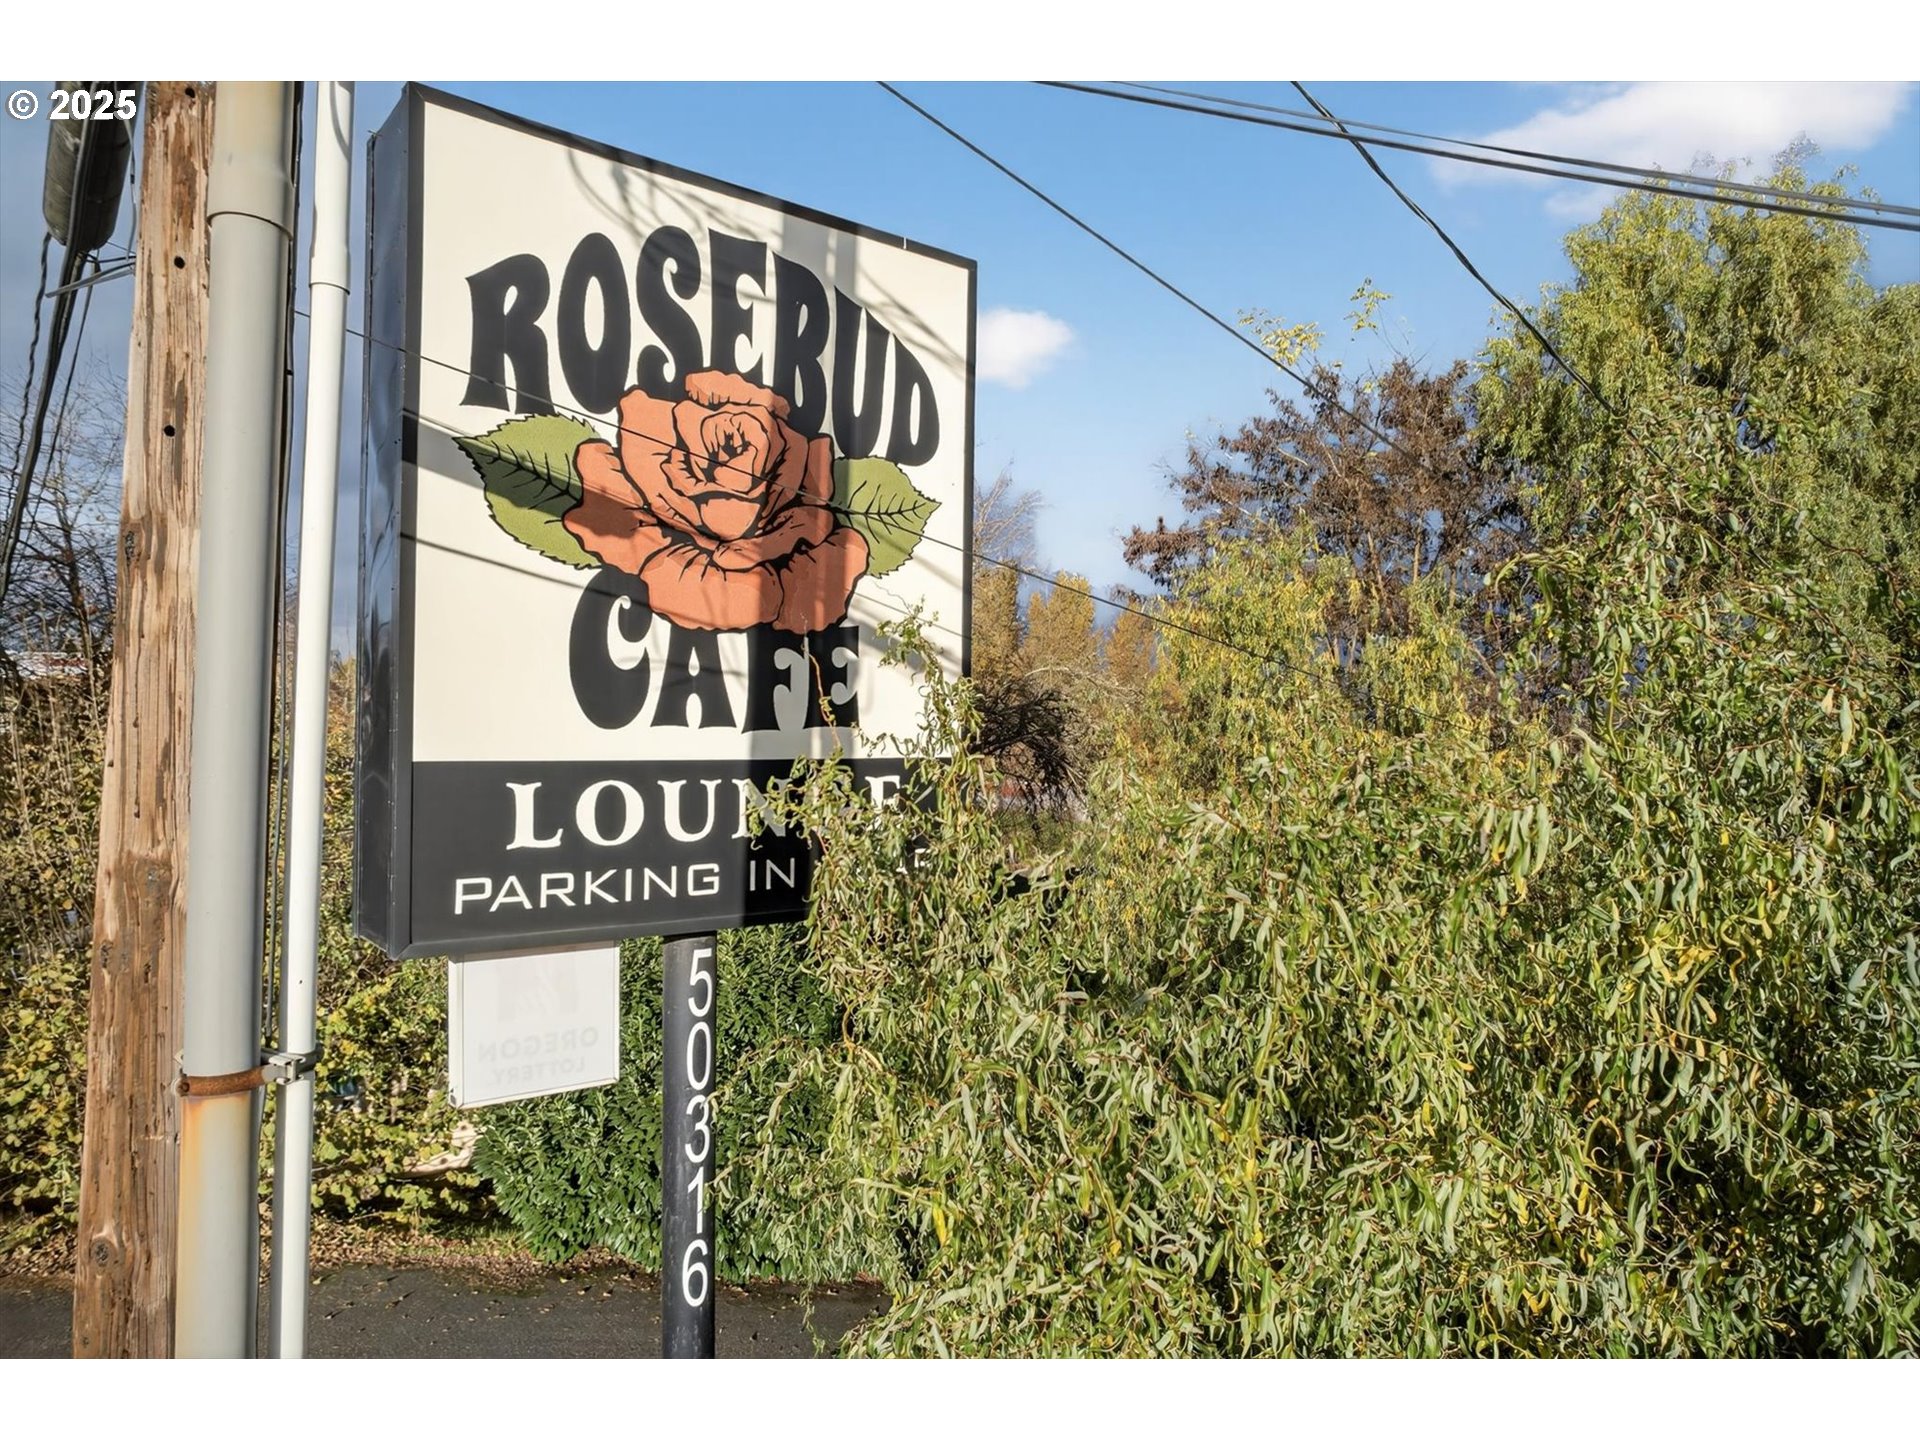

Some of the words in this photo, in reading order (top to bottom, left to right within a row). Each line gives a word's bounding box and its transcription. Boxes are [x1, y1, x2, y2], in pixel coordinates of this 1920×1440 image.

[459, 224, 940, 467] ROSEBUD
[568, 566, 860, 733] CAFE
[505, 775, 904, 850] LOUNE
[454, 862, 720, 916] PARKING
[750, 857, 795, 892] IN
